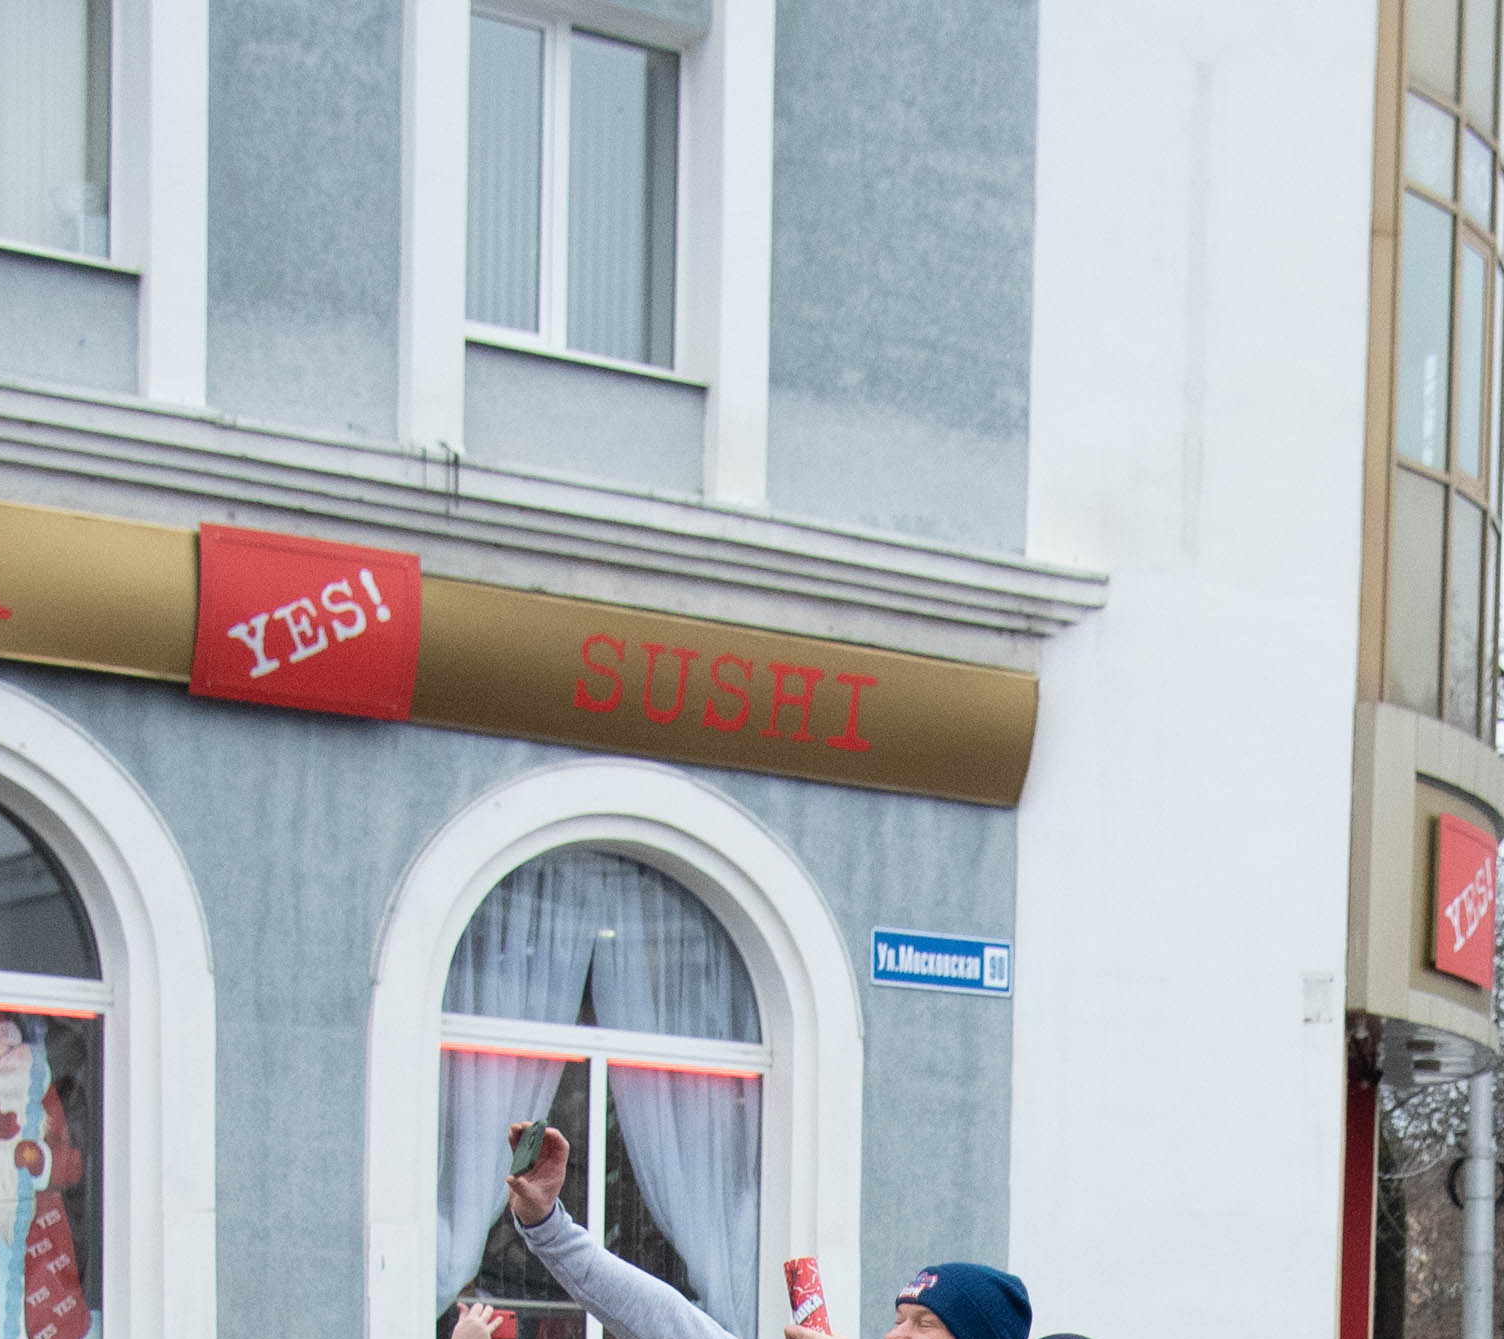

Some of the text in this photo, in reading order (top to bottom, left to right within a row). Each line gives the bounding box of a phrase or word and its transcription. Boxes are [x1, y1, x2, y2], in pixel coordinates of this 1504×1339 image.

[228, 568, 392, 681] YES!
[573, 633, 879, 752] SUSHI
[1445, 857, 1494, 952] YES!
[36, 1209, 61, 1229] YES
[28, 1238, 52, 1258] YES
[46, 1253, 71, 1274] YES
[27, 1286, 51, 1307] YES
[53, 1295, 77, 1317] YES
